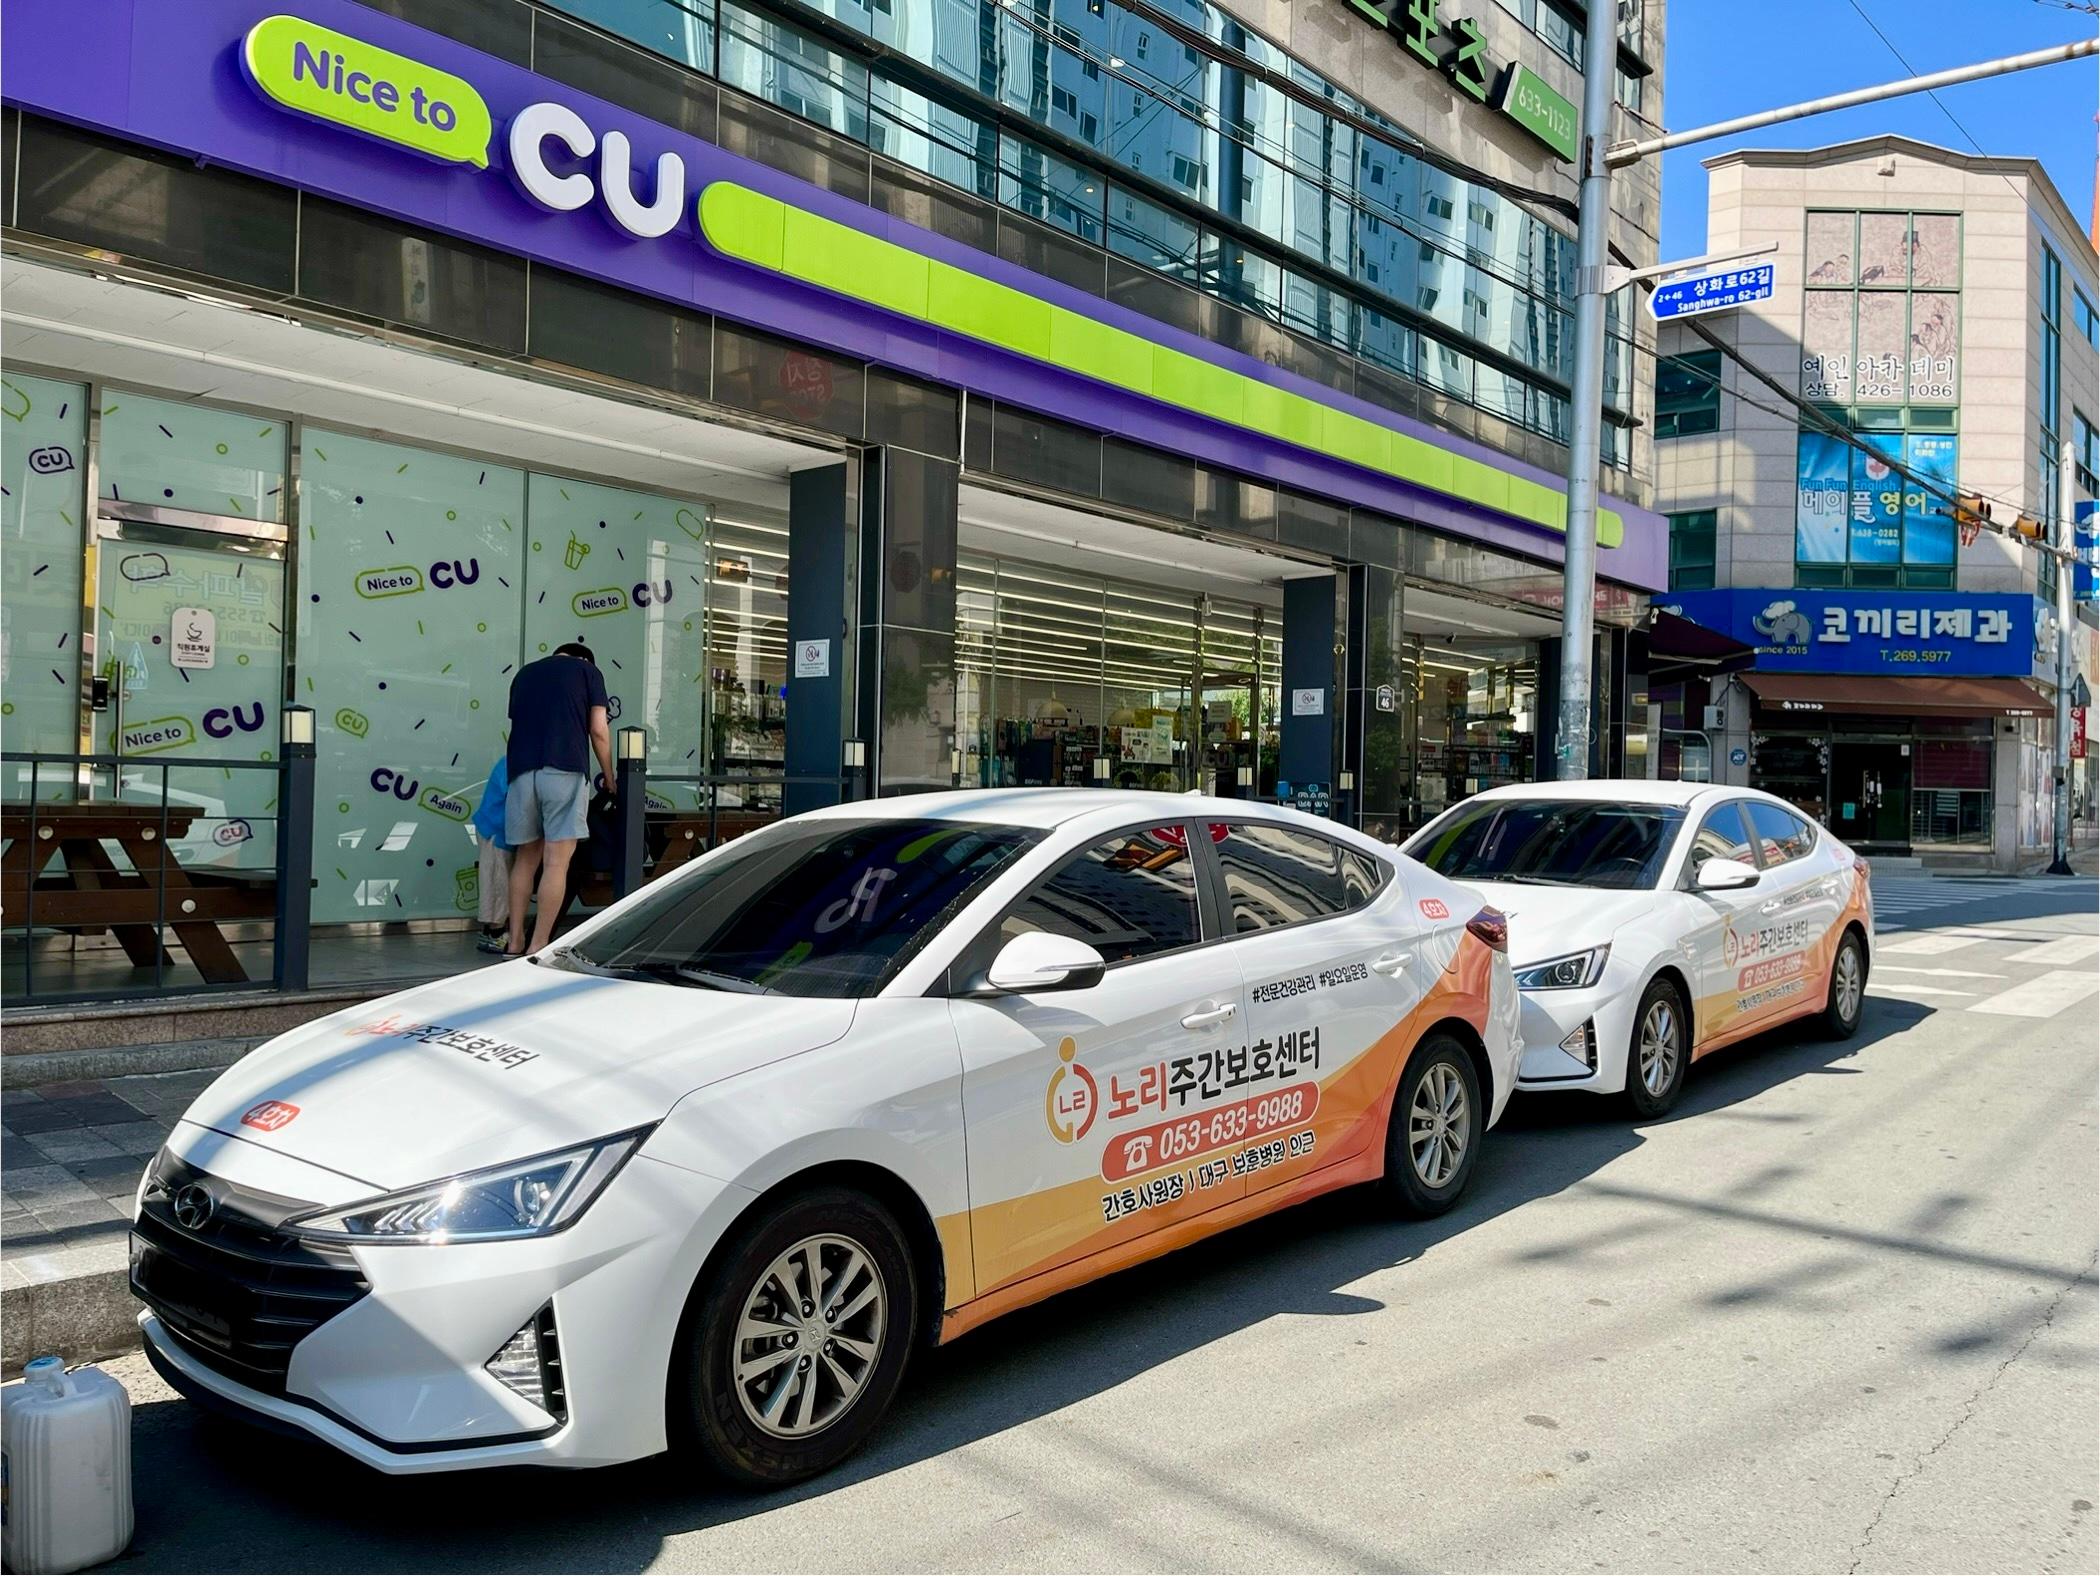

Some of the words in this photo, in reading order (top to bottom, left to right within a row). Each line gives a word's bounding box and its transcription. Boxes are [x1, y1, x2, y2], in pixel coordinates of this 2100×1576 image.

[1518, 86, 1571, 140] 633-1123
[293, 42, 399, 112] Nice
[411, 87, 456, 132] to
[509, 102, 685, 238] CU
[1694, 268, 1770, 297] 상화로62길
[1677, 294, 1735, 313] Sanghwa-ro
[1738, 287, 1769, 303] 62-gil
[1804, 355, 1849, 382] 예인
[1857, 384, 1953, 398] 426-1086
[37, 453, 63, 468] CU
[1801, 479, 1823, 492] Fun
[1825, 478, 1848, 492] Fun
[1803, 491, 1876, 524] 메이플
[1880, 491, 1928, 515] 영어
[367, 578, 397, 591] Nice
[399, 576, 413, 586] to
[430, 558, 479, 589] CU
[582, 598, 606, 610] Nice
[608, 596, 619, 606] to
[632, 579, 673, 608] CU
[1817, 607, 2013, 643] 코끼리제과
[1786, 646, 1808, 655] 2015
[1880, 650, 1951, 662] T.269.5977
[125, 731, 162, 748] Nice
[165, 728, 182, 739] to
[203, 702, 264, 738] CU
[342, 714, 363, 730] CU
[370, 768, 418, 800] CU
[430, 794, 462, 814] Again
[220, 826, 243, 841] CU
[1252, 974, 1317, 1003] #전문건강관리
[1319, 963, 1369, 987] #일요일운영
[1108, 1027, 1320, 1119] 노리주간보호센터
[1159, 1090, 1304, 1160] 053-633-9988
[1102, 1172, 1184, 1222] 간호사원장
[1200, 1159, 1229, 1188] 대구
[1232, 1140, 1286, 1177] 보훈병원
[1289, 1131, 1315, 1157] 인근
